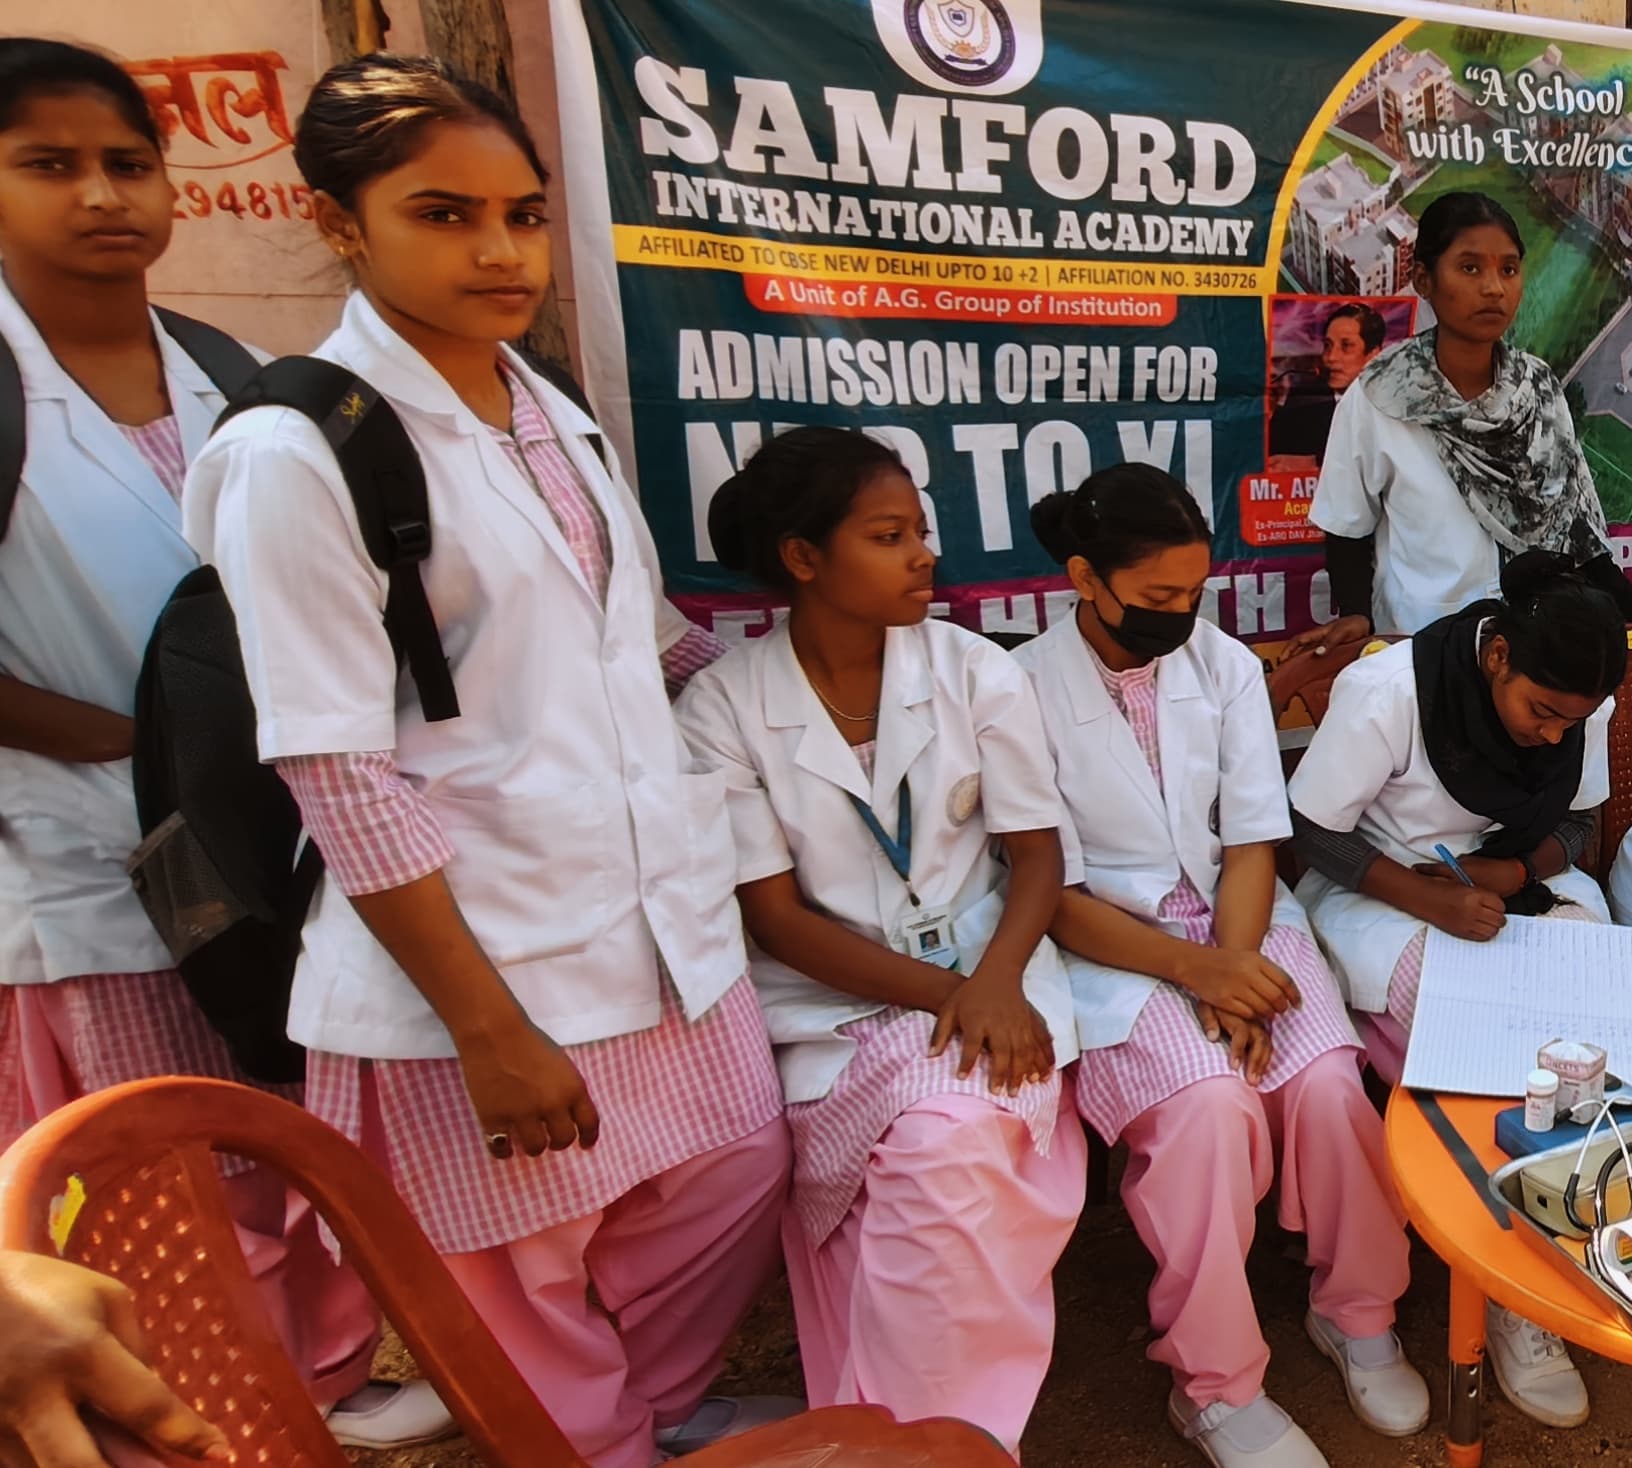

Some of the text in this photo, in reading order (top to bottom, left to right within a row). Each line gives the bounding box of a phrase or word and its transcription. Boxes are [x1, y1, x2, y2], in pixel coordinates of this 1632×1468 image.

[1516, 71, 1624, 115] School
[634, 55, 1257, 207] SAMFORD
[1406, 124, 1485, 165] with
[652, 171, 1253, 256] INTERNATIONAL ACADEMY
[639, 235, 1257, 289] AFFILIATED TO CBSE NEW DELHI UPTO 10 +2 AFFILIATION NO. 3430726
[764, 280, 1163, 317] A Unit of A.G. Group of Institution
[678, 328, 1219, 406] ADMISSION OPEN FOR
[1250, 478, 1283, 500] Mr.
